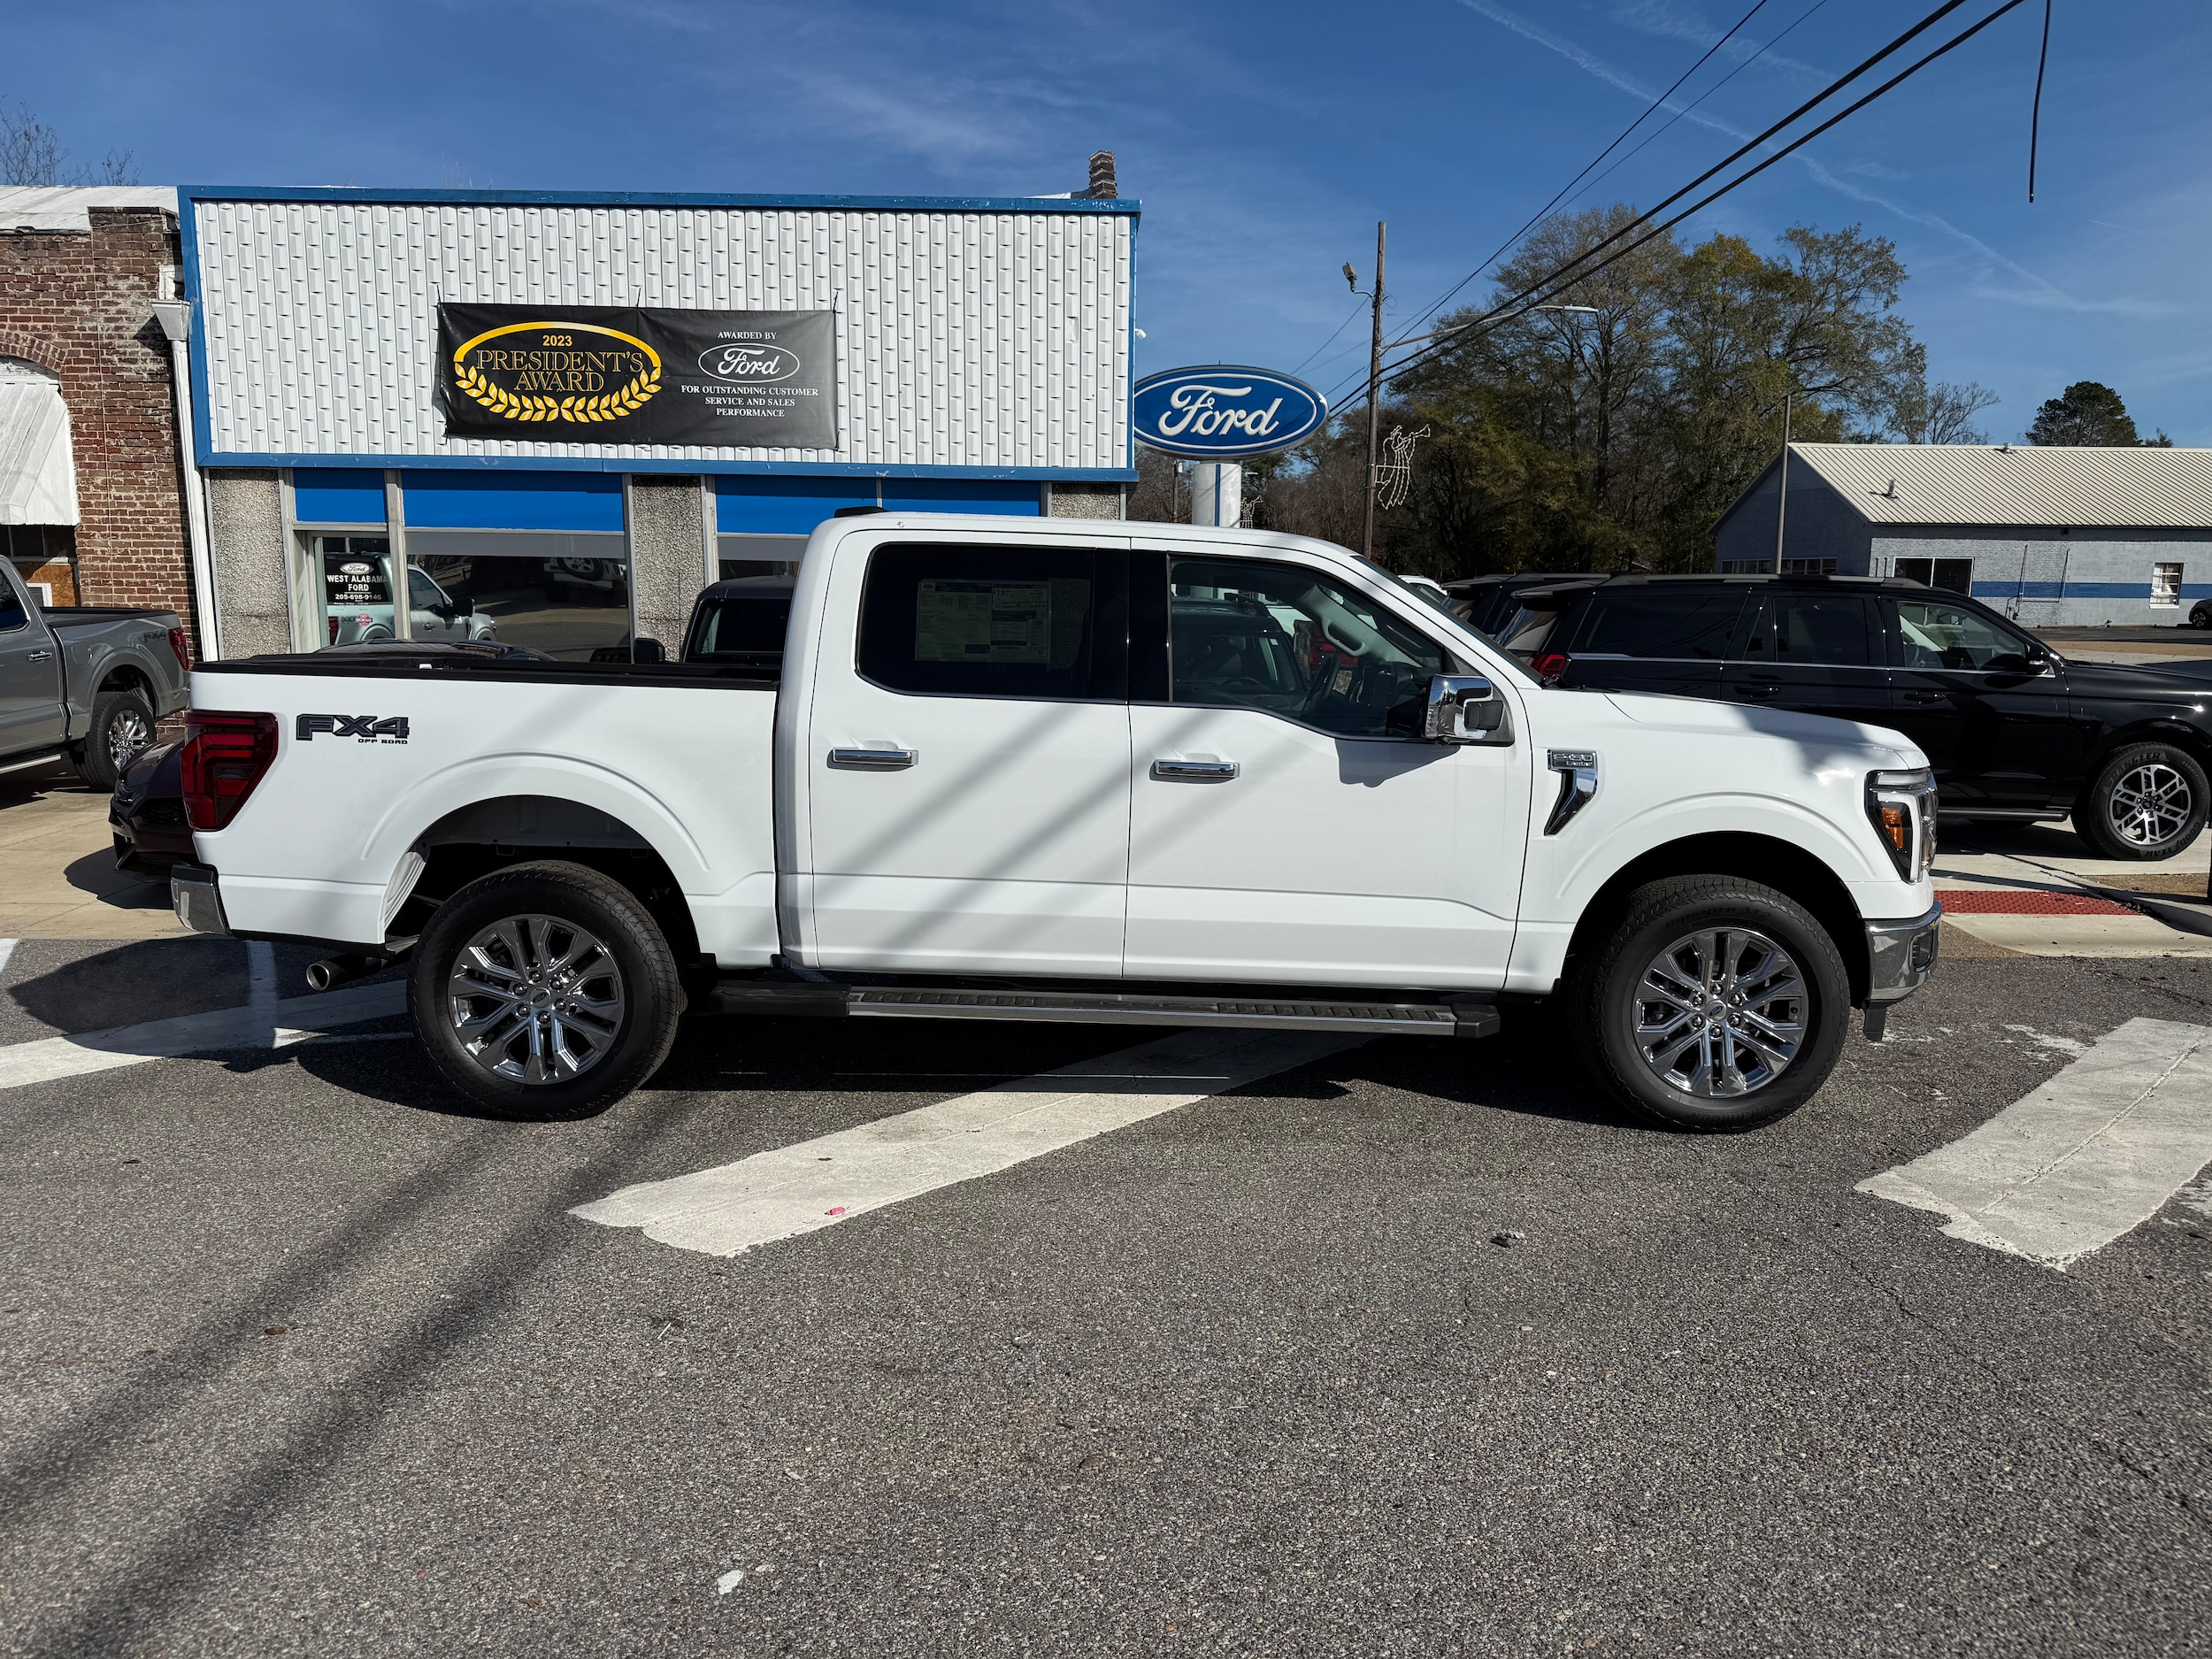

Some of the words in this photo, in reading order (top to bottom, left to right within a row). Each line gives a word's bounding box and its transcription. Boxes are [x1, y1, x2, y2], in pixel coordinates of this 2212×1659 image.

[542, 334, 572, 346] 2023
[718, 331, 762, 340] AWARDED
[476, 349, 643, 373] PRESIDENT'S
[718, 348, 780, 375] Ford
[513, 372, 604, 392] AWARD
[680, 385, 700, 394] FOR
[702, 386, 766, 396] OUTSTANDING
[768, 388, 818, 396] CUSTOMER
[704, 396, 745, 405] SERVICE
[746, 397, 765, 406] AND
[767, 398, 795, 407] SALES
[716, 408, 786, 418] PERFORMANCE
[1157, 384, 1284, 437] Ford
[326, 574, 349, 583] WEST
[350, 574, 388, 583] ALABAMA
[348, 583, 370, 592] FORD
[296, 713, 410, 741] FX4
[1553, 752, 1593, 762] F-150
[2105, 751, 2161, 789] WRANGLER
